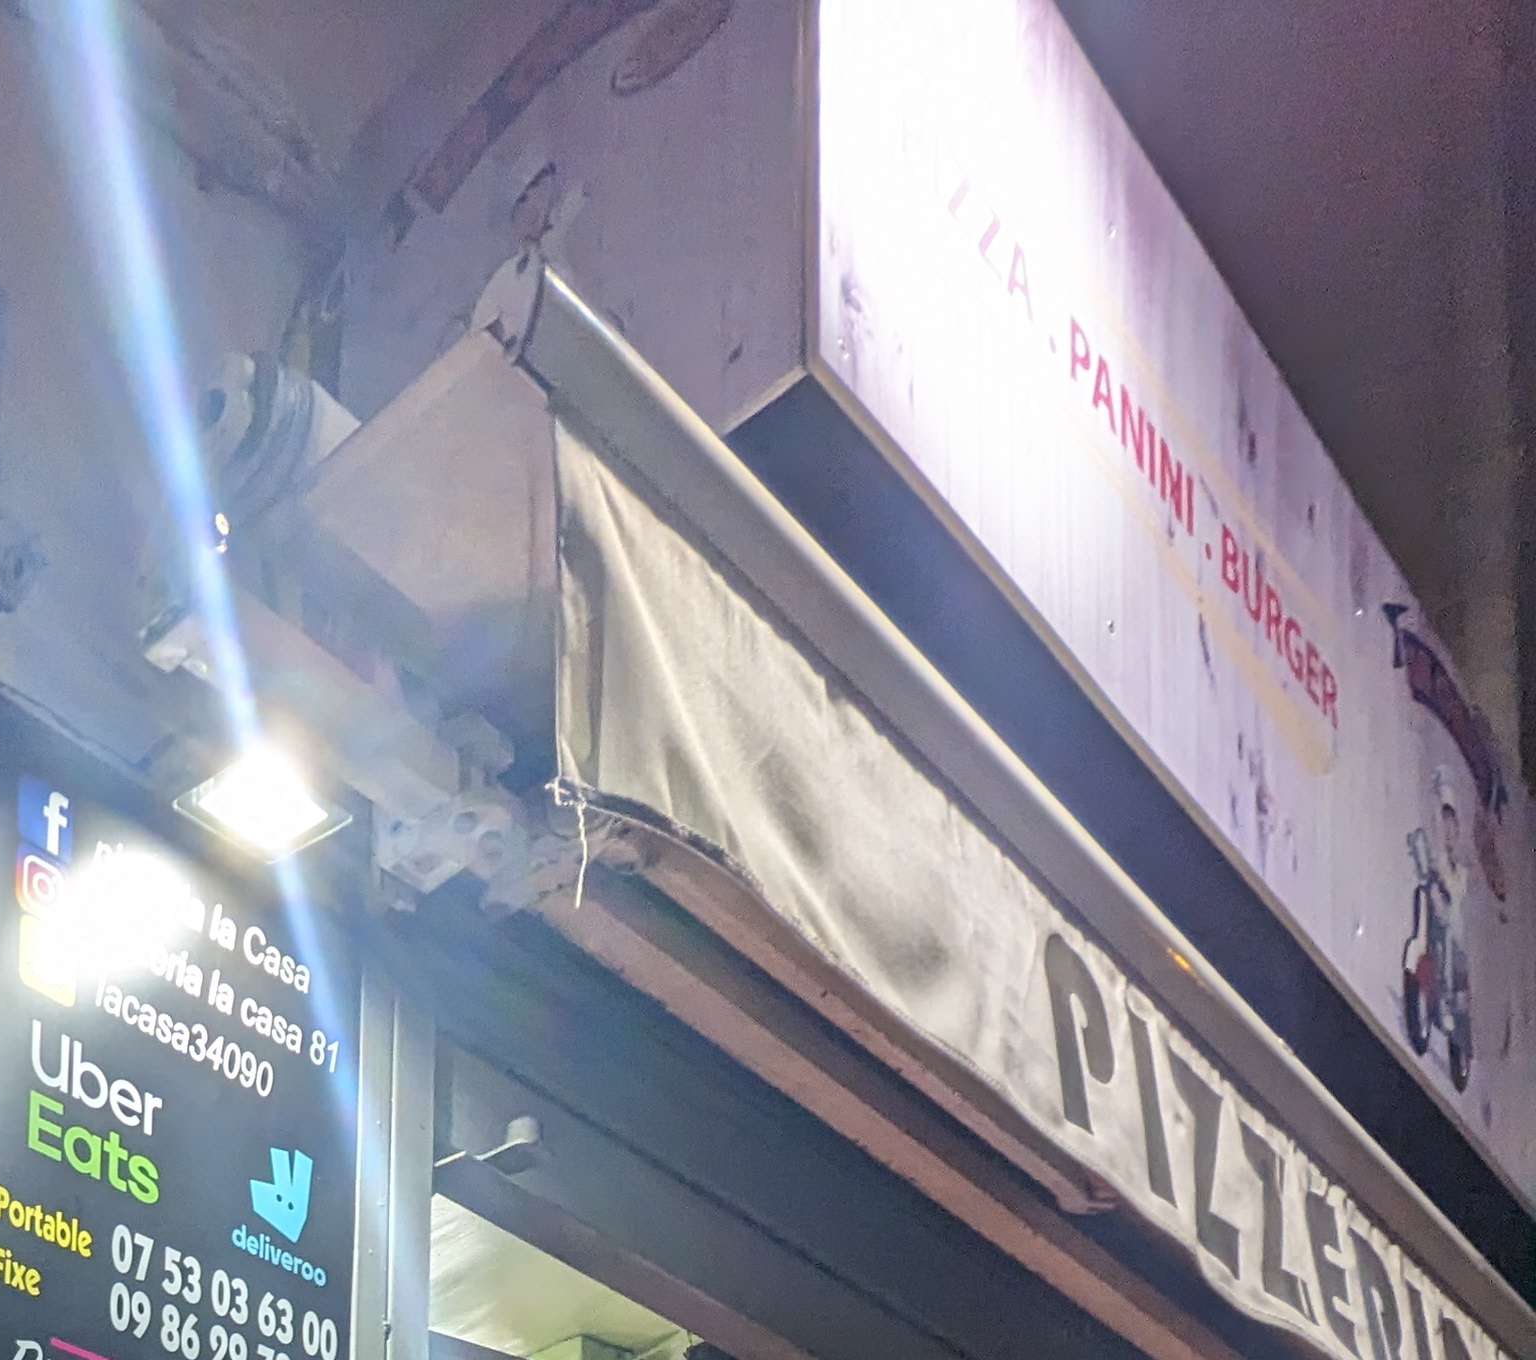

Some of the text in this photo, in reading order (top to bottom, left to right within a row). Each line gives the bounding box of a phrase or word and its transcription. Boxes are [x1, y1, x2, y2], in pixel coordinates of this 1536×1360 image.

[1070, 315, 1194, 536] PANINI
[1221, 523, 1339, 729] BURGER
[209, 903, 311, 994] la Casa
[31, 1019, 163, 1135] Uber
[95, 972, 274, 1097] lacasa34090
[208, 968, 234, 1015] la
[240, 998, 303, 1054] casa
[310, 1030, 340, 1073] 81
[27, 1090, 161, 1205] Eats
[111, 1224, 154, 1281] 07
[162, 1246, 202, 1304] 53
[211, 1269, 249, 1325] 03
[258, 1291, 294, 1345] 63
[231, 1224, 327, 1287] deliveroo
[110, 1282, 152, 1339] 09
[161, 1304, 200, 1360] 86
